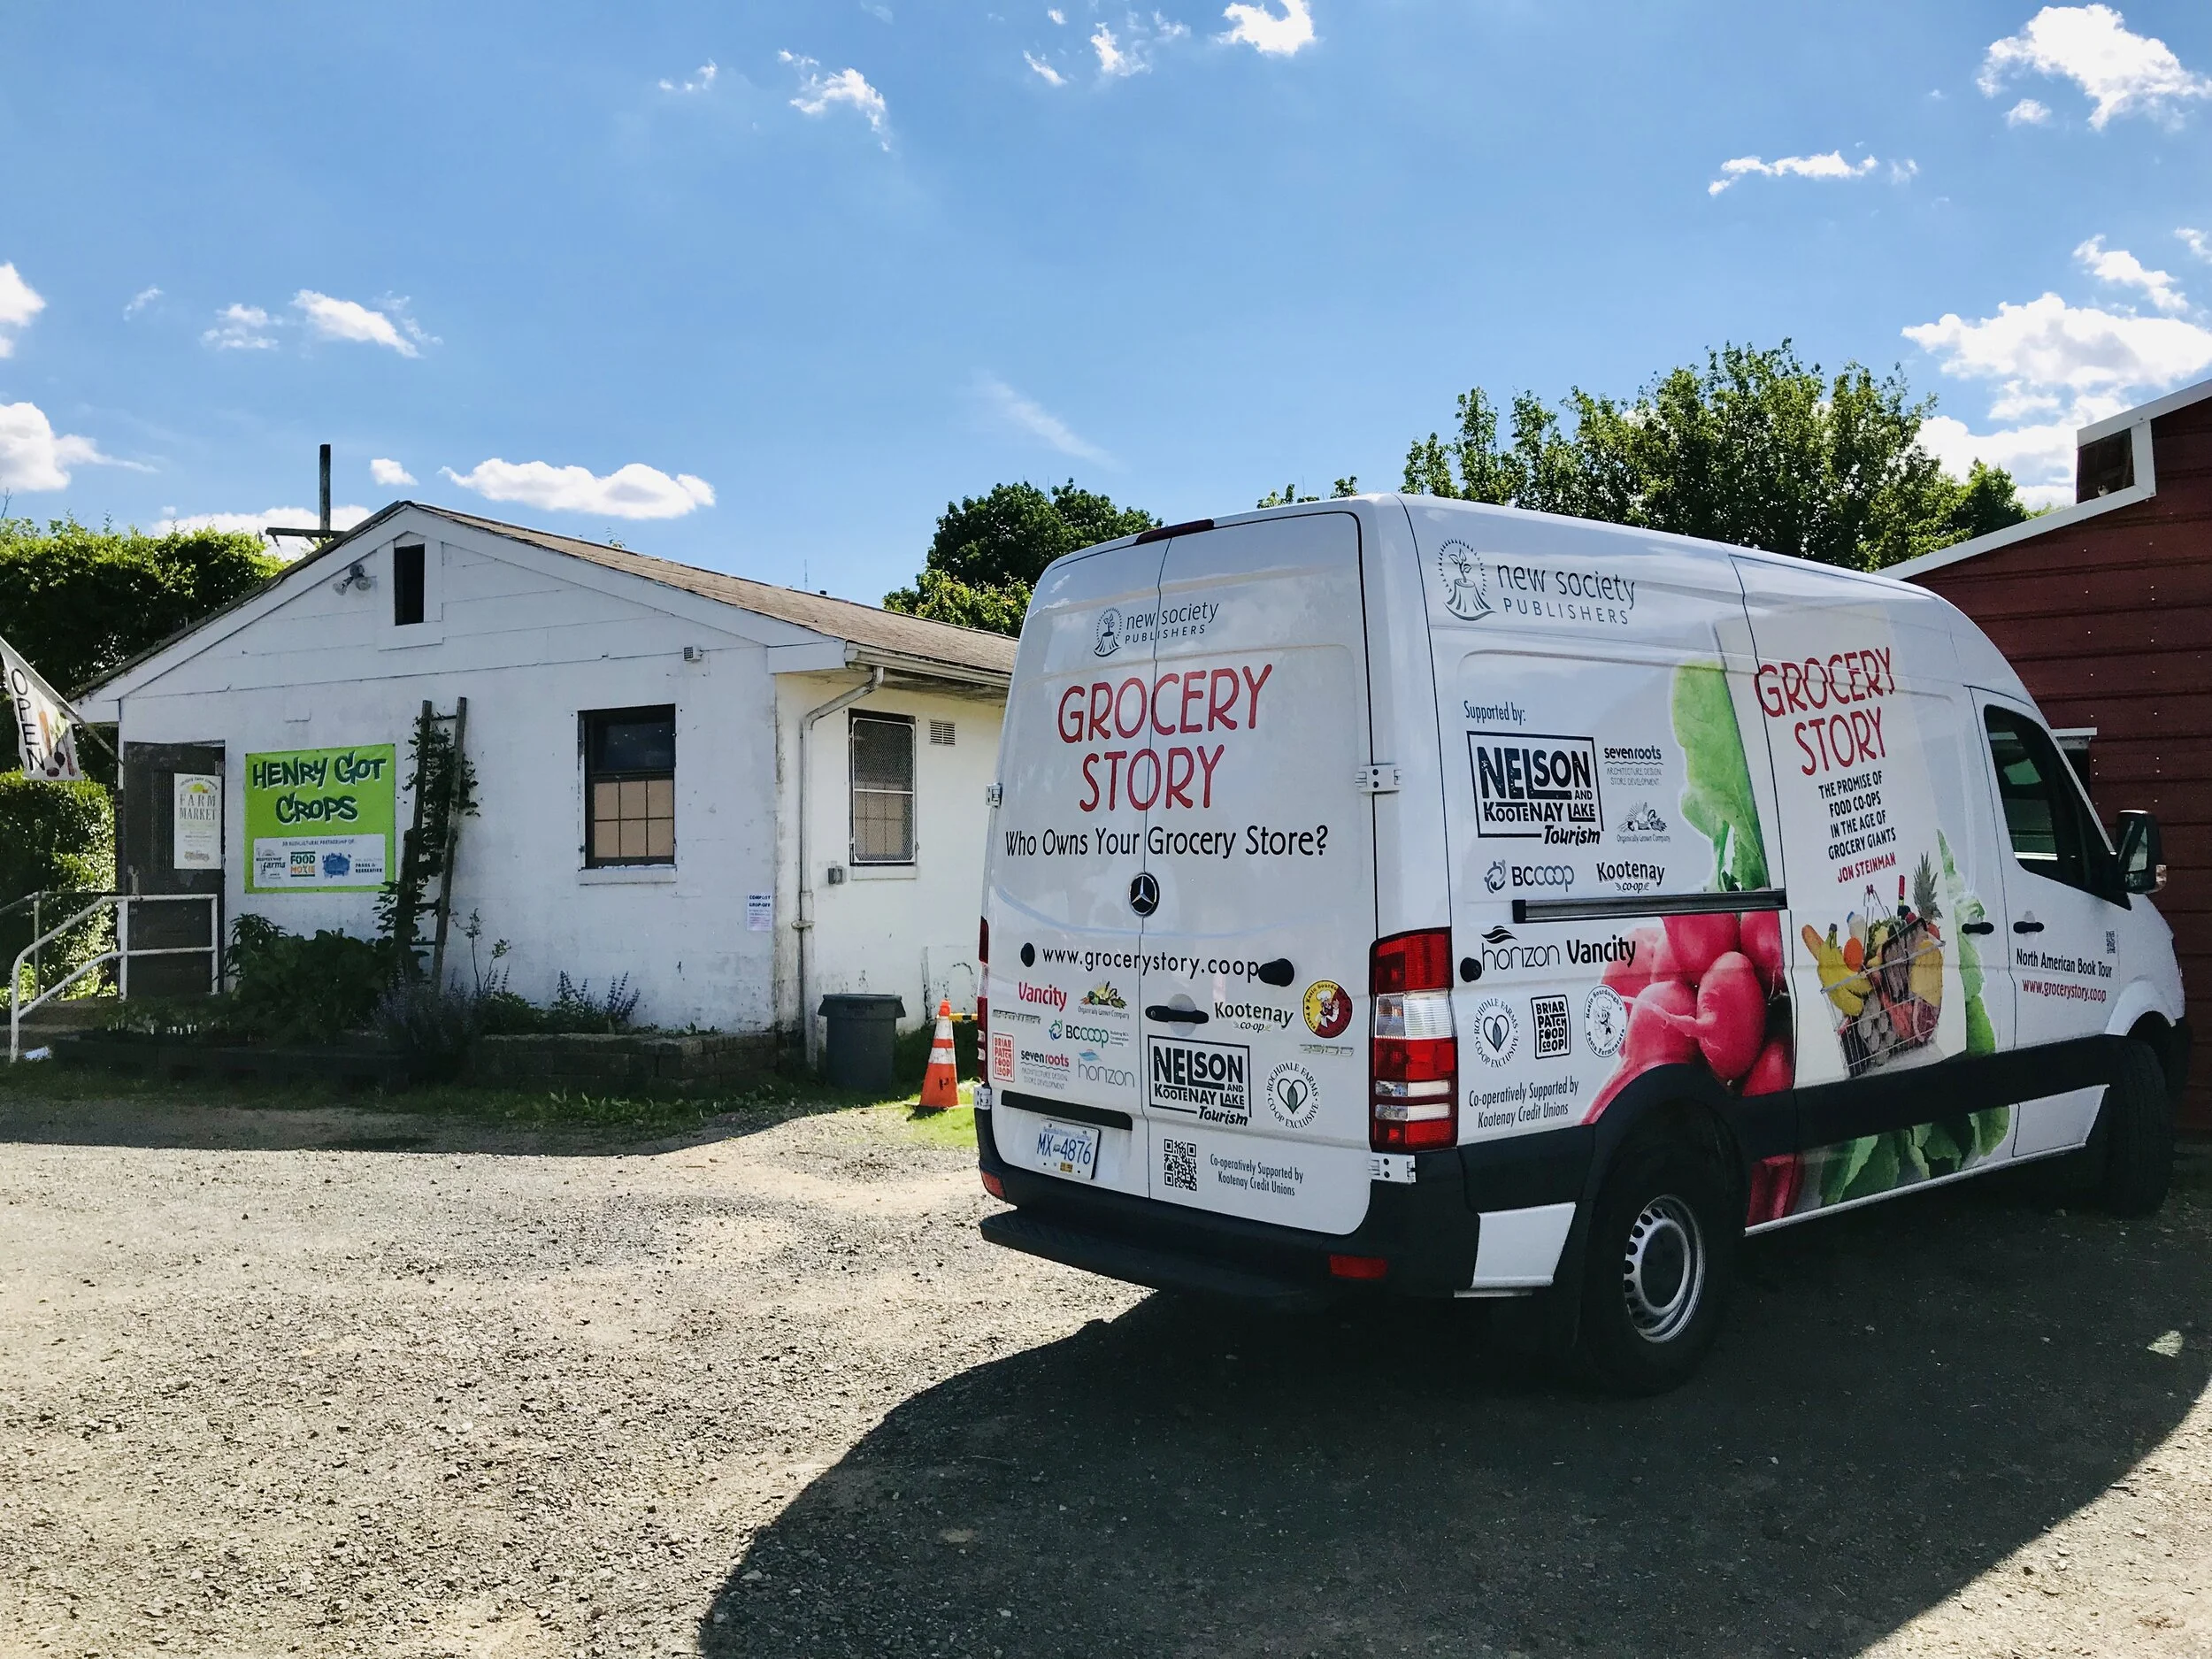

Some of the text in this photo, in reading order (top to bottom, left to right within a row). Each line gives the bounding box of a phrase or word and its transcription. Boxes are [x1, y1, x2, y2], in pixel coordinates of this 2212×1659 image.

[1497, 564, 1635, 611] new society
[1125, 602, 1219, 630] new society
[1503, 597, 1628, 625] PUBLISHERS
[1125, 625, 1205, 644] PUBLISHERS
[1755, 647, 1895, 718] GROCERY
[1057, 664, 1272, 743] GROCERY
[1463, 700, 1526, 726] Supported by:
[12, 668, 45, 771] OPEN
[1794, 706, 1886, 776] STORY
[253, 757, 329, 789] HENRY
[1079, 744, 1225, 812] STORY
[1477, 746, 1591, 800] NELSON
[1818, 770, 1882, 799] THE PROMISE OF
[180, 794, 217, 807] FARM
[1575, 790, 1593, 800] AND
[1829, 790, 1881, 818] FOOD CO-OPS
[179, 807, 216, 821] MARKET
[1482, 802, 1595, 823] KOOTENAY LAKE
[1830, 810, 1886, 839] IN THE AGE OF
[1005, 825, 1328, 859] Who Owns Your Grocery Store?
[1544, 825, 1601, 847] Tourism
[1828, 826, 1897, 860] GROCERY GIANTS
[290, 855, 316, 864] FOOD
[1596, 860, 1665, 886] Kootenay
[1838, 852, 1897, 883] JON STEINMAN
[1042, 948, 1260, 983] www.grocerystory.coop
[1481, 934, 1636, 971] horizon Vancity
[2016, 948, 2112, 978] North American Book Tour
[1018, 981, 1067, 1012] Vancity
[2022, 979, 2107, 1003] www.grocerystory.coop
[1215, 1002, 1294, 1028] Kootenay
[1240, 1021, 1265, 1033] co-op
[1501, 1001, 1519, 1029] FARMS
[1539, 1027, 1564, 1040] FOOD
[1153, 1046, 1243, 1089] NELSON
[1266, 1063, 1319, 1097] ROCHDALE FARMS
[1155, 1083, 1245, 1110] KOOTENAY LAKE
[1227, 1084, 1244, 1093] AND
[1469, 1075, 1579, 1109] Co-operatively Supported by
[1199, 1106, 1248, 1126] Tourism
[1285, 1102, 1318, 1129] EXCLUSIVE
[1478, 1102, 1569, 1128] Kootenay Credit Unions
[1037, 1133, 1054, 1157] MX
[1060, 1138, 1093, 1164] 4876
[1210, 1154, 1303, 1184] Co-operatively Supported by
[1217, 1171, 1295, 1196] Kootenay Credit Unions
